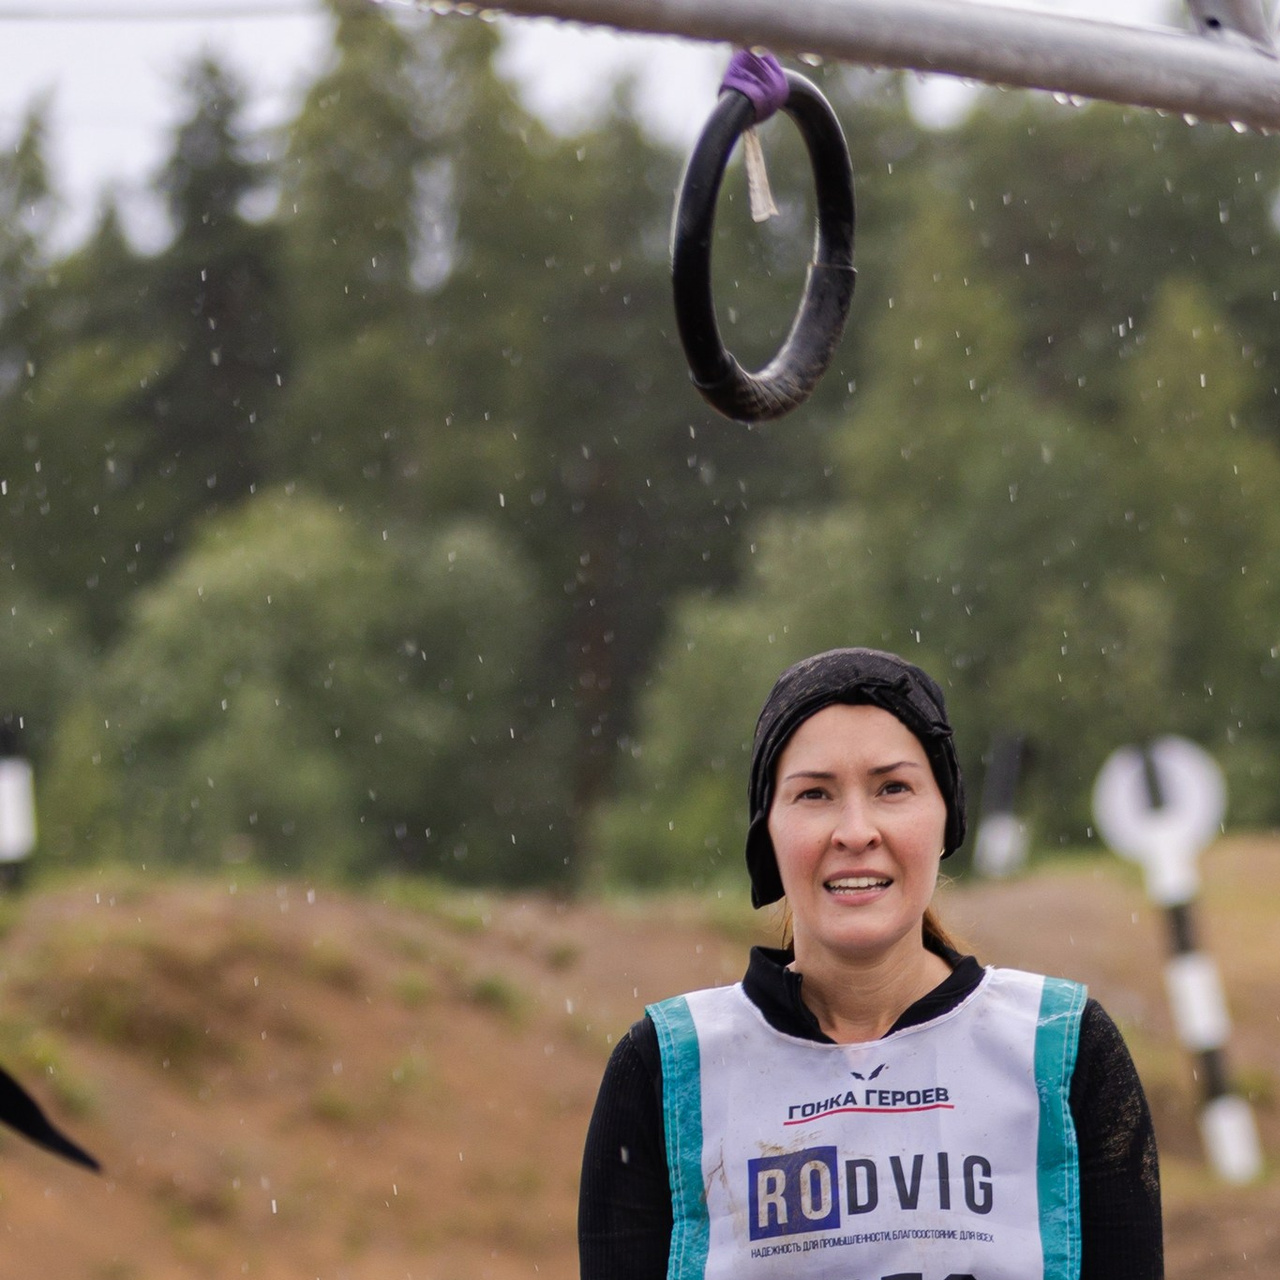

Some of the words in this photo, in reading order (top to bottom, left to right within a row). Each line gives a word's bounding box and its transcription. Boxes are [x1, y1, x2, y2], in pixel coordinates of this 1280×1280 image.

[788, 1091, 858, 1119] ГОНКА
[865, 1087, 949, 1107] ГЕРОЕВ
[757, 1152, 993, 1229] RODVIG
[803, 1240, 819, 1252] ДЛЯ
[960, 1230, 975, 1240] ДЛЯ
[976, 1232, 994, 1242] ВСЕХ
